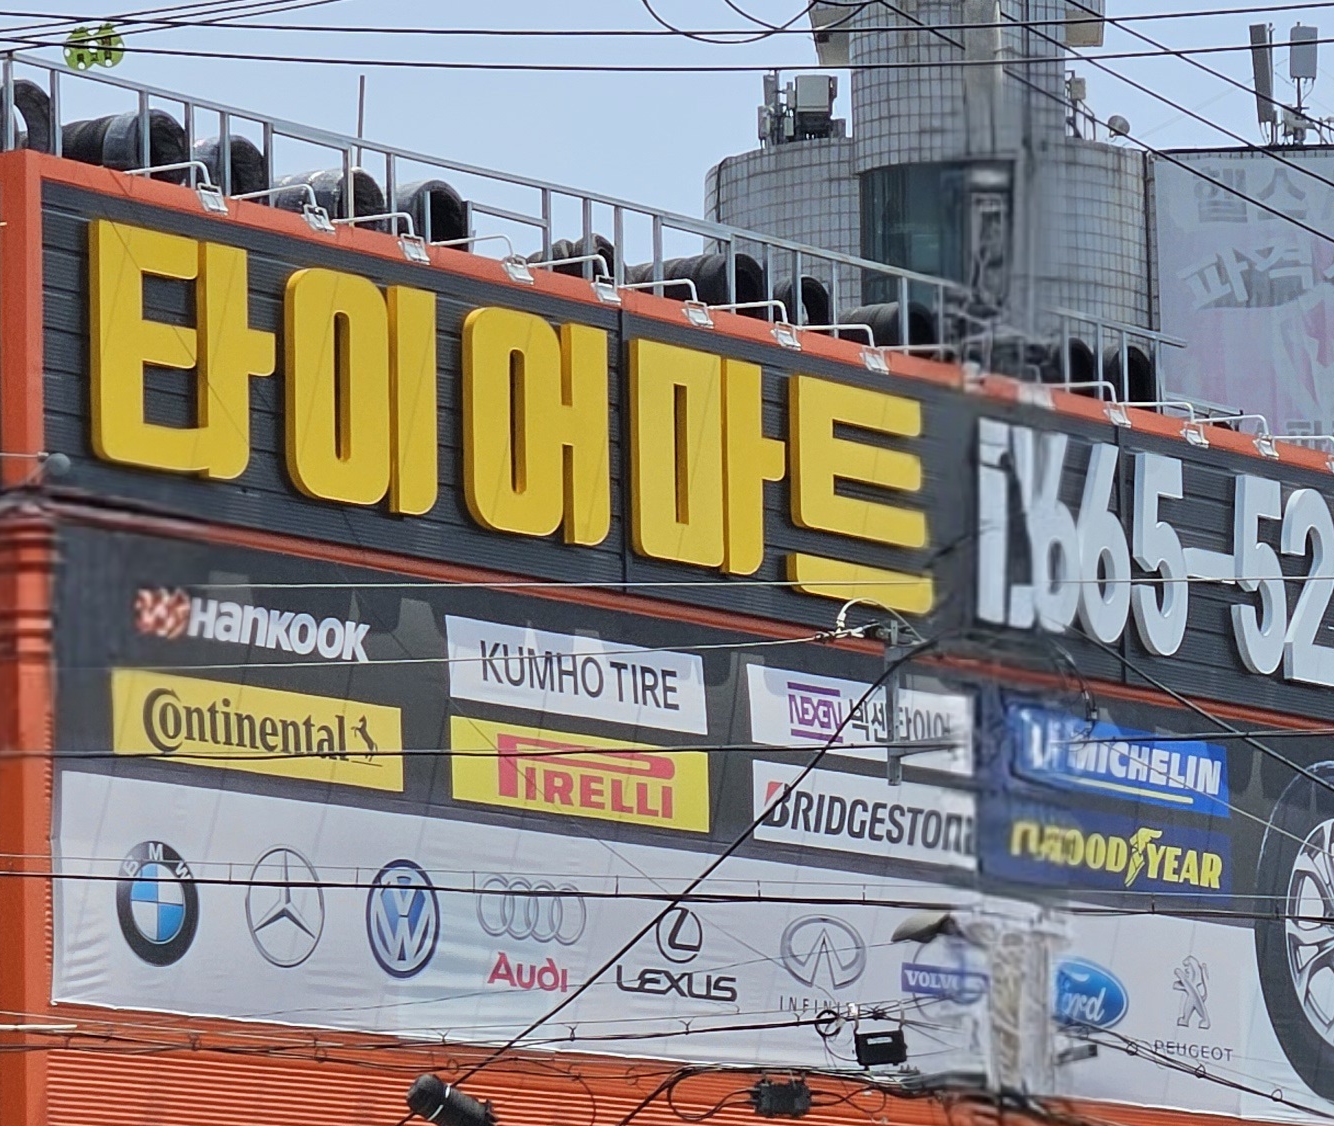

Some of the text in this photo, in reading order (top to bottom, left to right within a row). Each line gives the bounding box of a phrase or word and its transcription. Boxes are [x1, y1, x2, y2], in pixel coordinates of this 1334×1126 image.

[88, 218, 935, 613] 타이어마트
[480, 640, 680, 711] KUMHO TIRE
[143, 687, 350, 763] Continental
[496, 733, 676, 820] PIRELLI
[488, 953, 567, 992] Audi
[616, 964, 737, 1002] LEXUS
